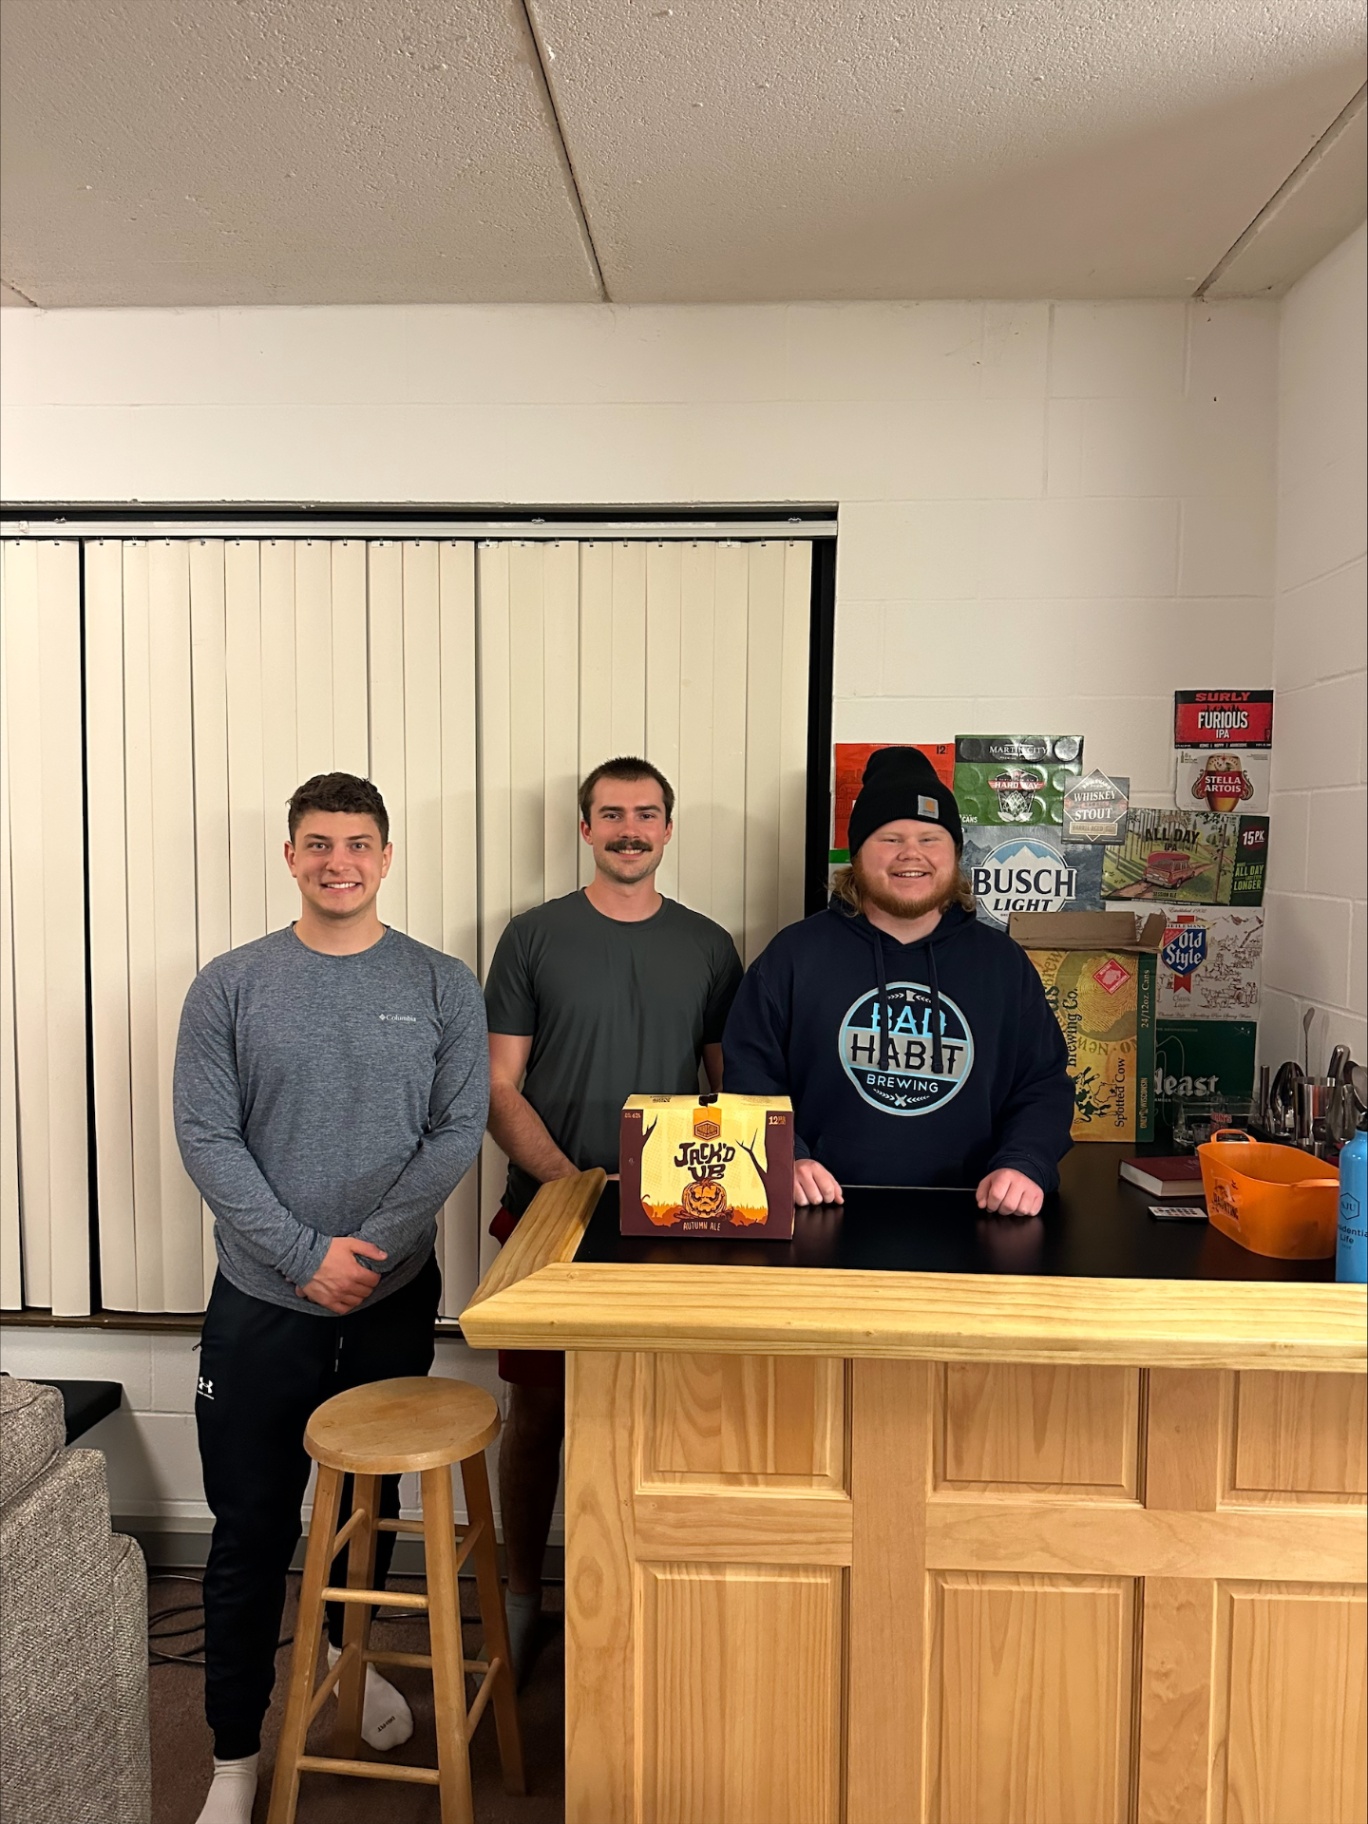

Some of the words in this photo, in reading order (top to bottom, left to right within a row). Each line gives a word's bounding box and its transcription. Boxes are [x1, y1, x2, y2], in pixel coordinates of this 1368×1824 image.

[1195, 692, 1251, 702] SURLY
[1198, 711, 1249, 729] FURIOUS
[1216, 729, 1230, 739] IPA
[936, 745, 947, 755] 12
[995, 781, 1019, 790] HARD
[1205, 776, 1242, 785] STELLA
[1204, 785, 1242, 793] ARTOIS
[1073, 790, 1117, 802] WHISKEY
[961, 816, 978, 824] CANS
[1074, 807, 1113, 821] STOUT
[1145, 828, 1170, 842] ALL
[1173, 828, 1200, 844] DAY
[1164, 843, 1178, 851] IPA
[1234, 865, 1248, 877] ALL
[1250, 864, 1264, 876] DAY
[973, 868, 1074, 897] BUSCH
[1233, 879, 1262, 891] LONGER
[993, 898, 1053, 912] LIGHT
[1179, 931, 1203, 949] Old
[1165, 943, 1202, 971] Style
[1141, 970, 1150, 990] Cans
[386, 1014, 417, 1022] Columbia
[871, 1002, 947, 1038] BAD
[850, 1033, 964, 1075] HABT
[1115, 1057, 1126, 1083] Cow
[866, 1073, 939, 1093] BREWING
[1114, 1084, 1127, 1127] Spotted
[768, 1115, 778, 1125] 12
[674, 1142, 736, 1168] JACK'D
[683, 1221, 708, 1231] AUTUMN
[709, 1222, 721, 1231] ALE
[1340, 1234, 1355, 1244] Life
